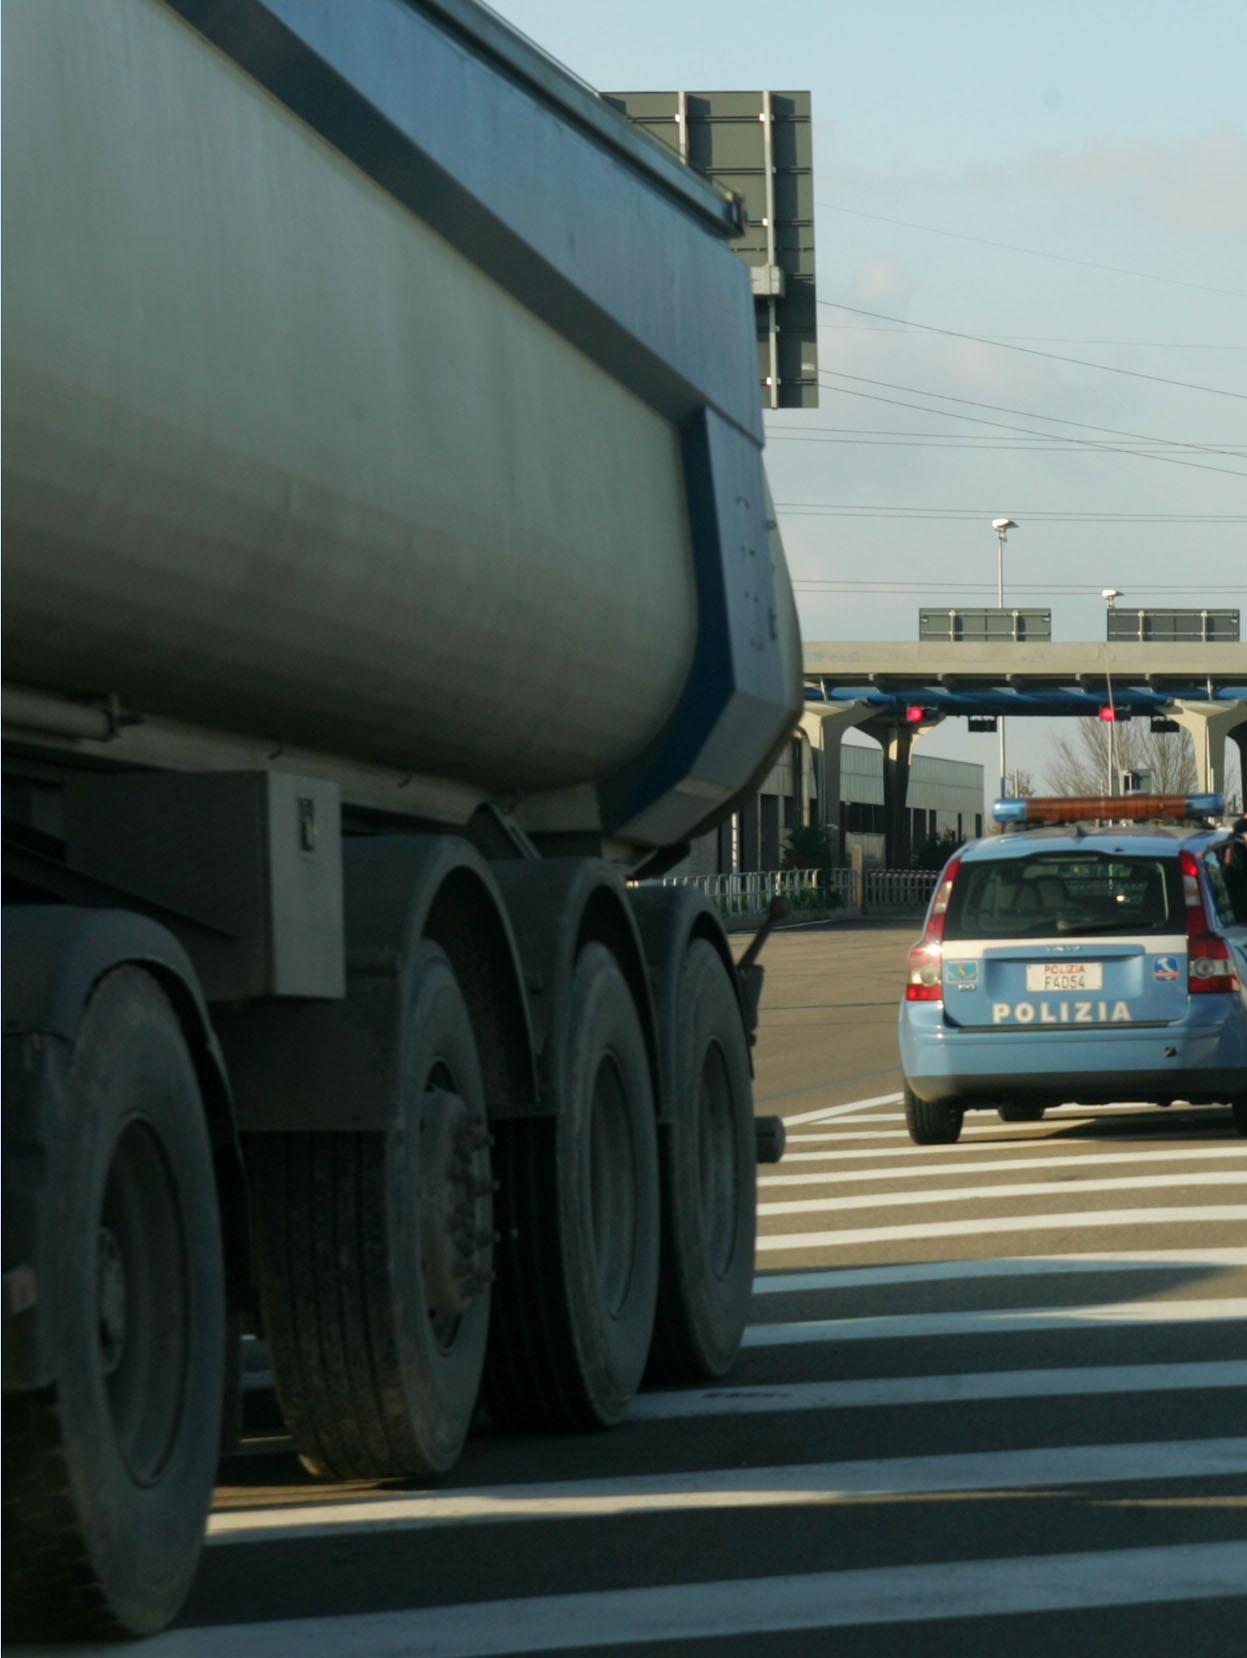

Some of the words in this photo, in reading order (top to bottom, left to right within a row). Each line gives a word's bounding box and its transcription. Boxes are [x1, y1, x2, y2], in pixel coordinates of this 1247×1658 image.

[1043, 965, 1087, 974] POLIZIA
[1043, 975, 1086, 989] F4054
[992, 1001, 1132, 1024] POLIZIA
